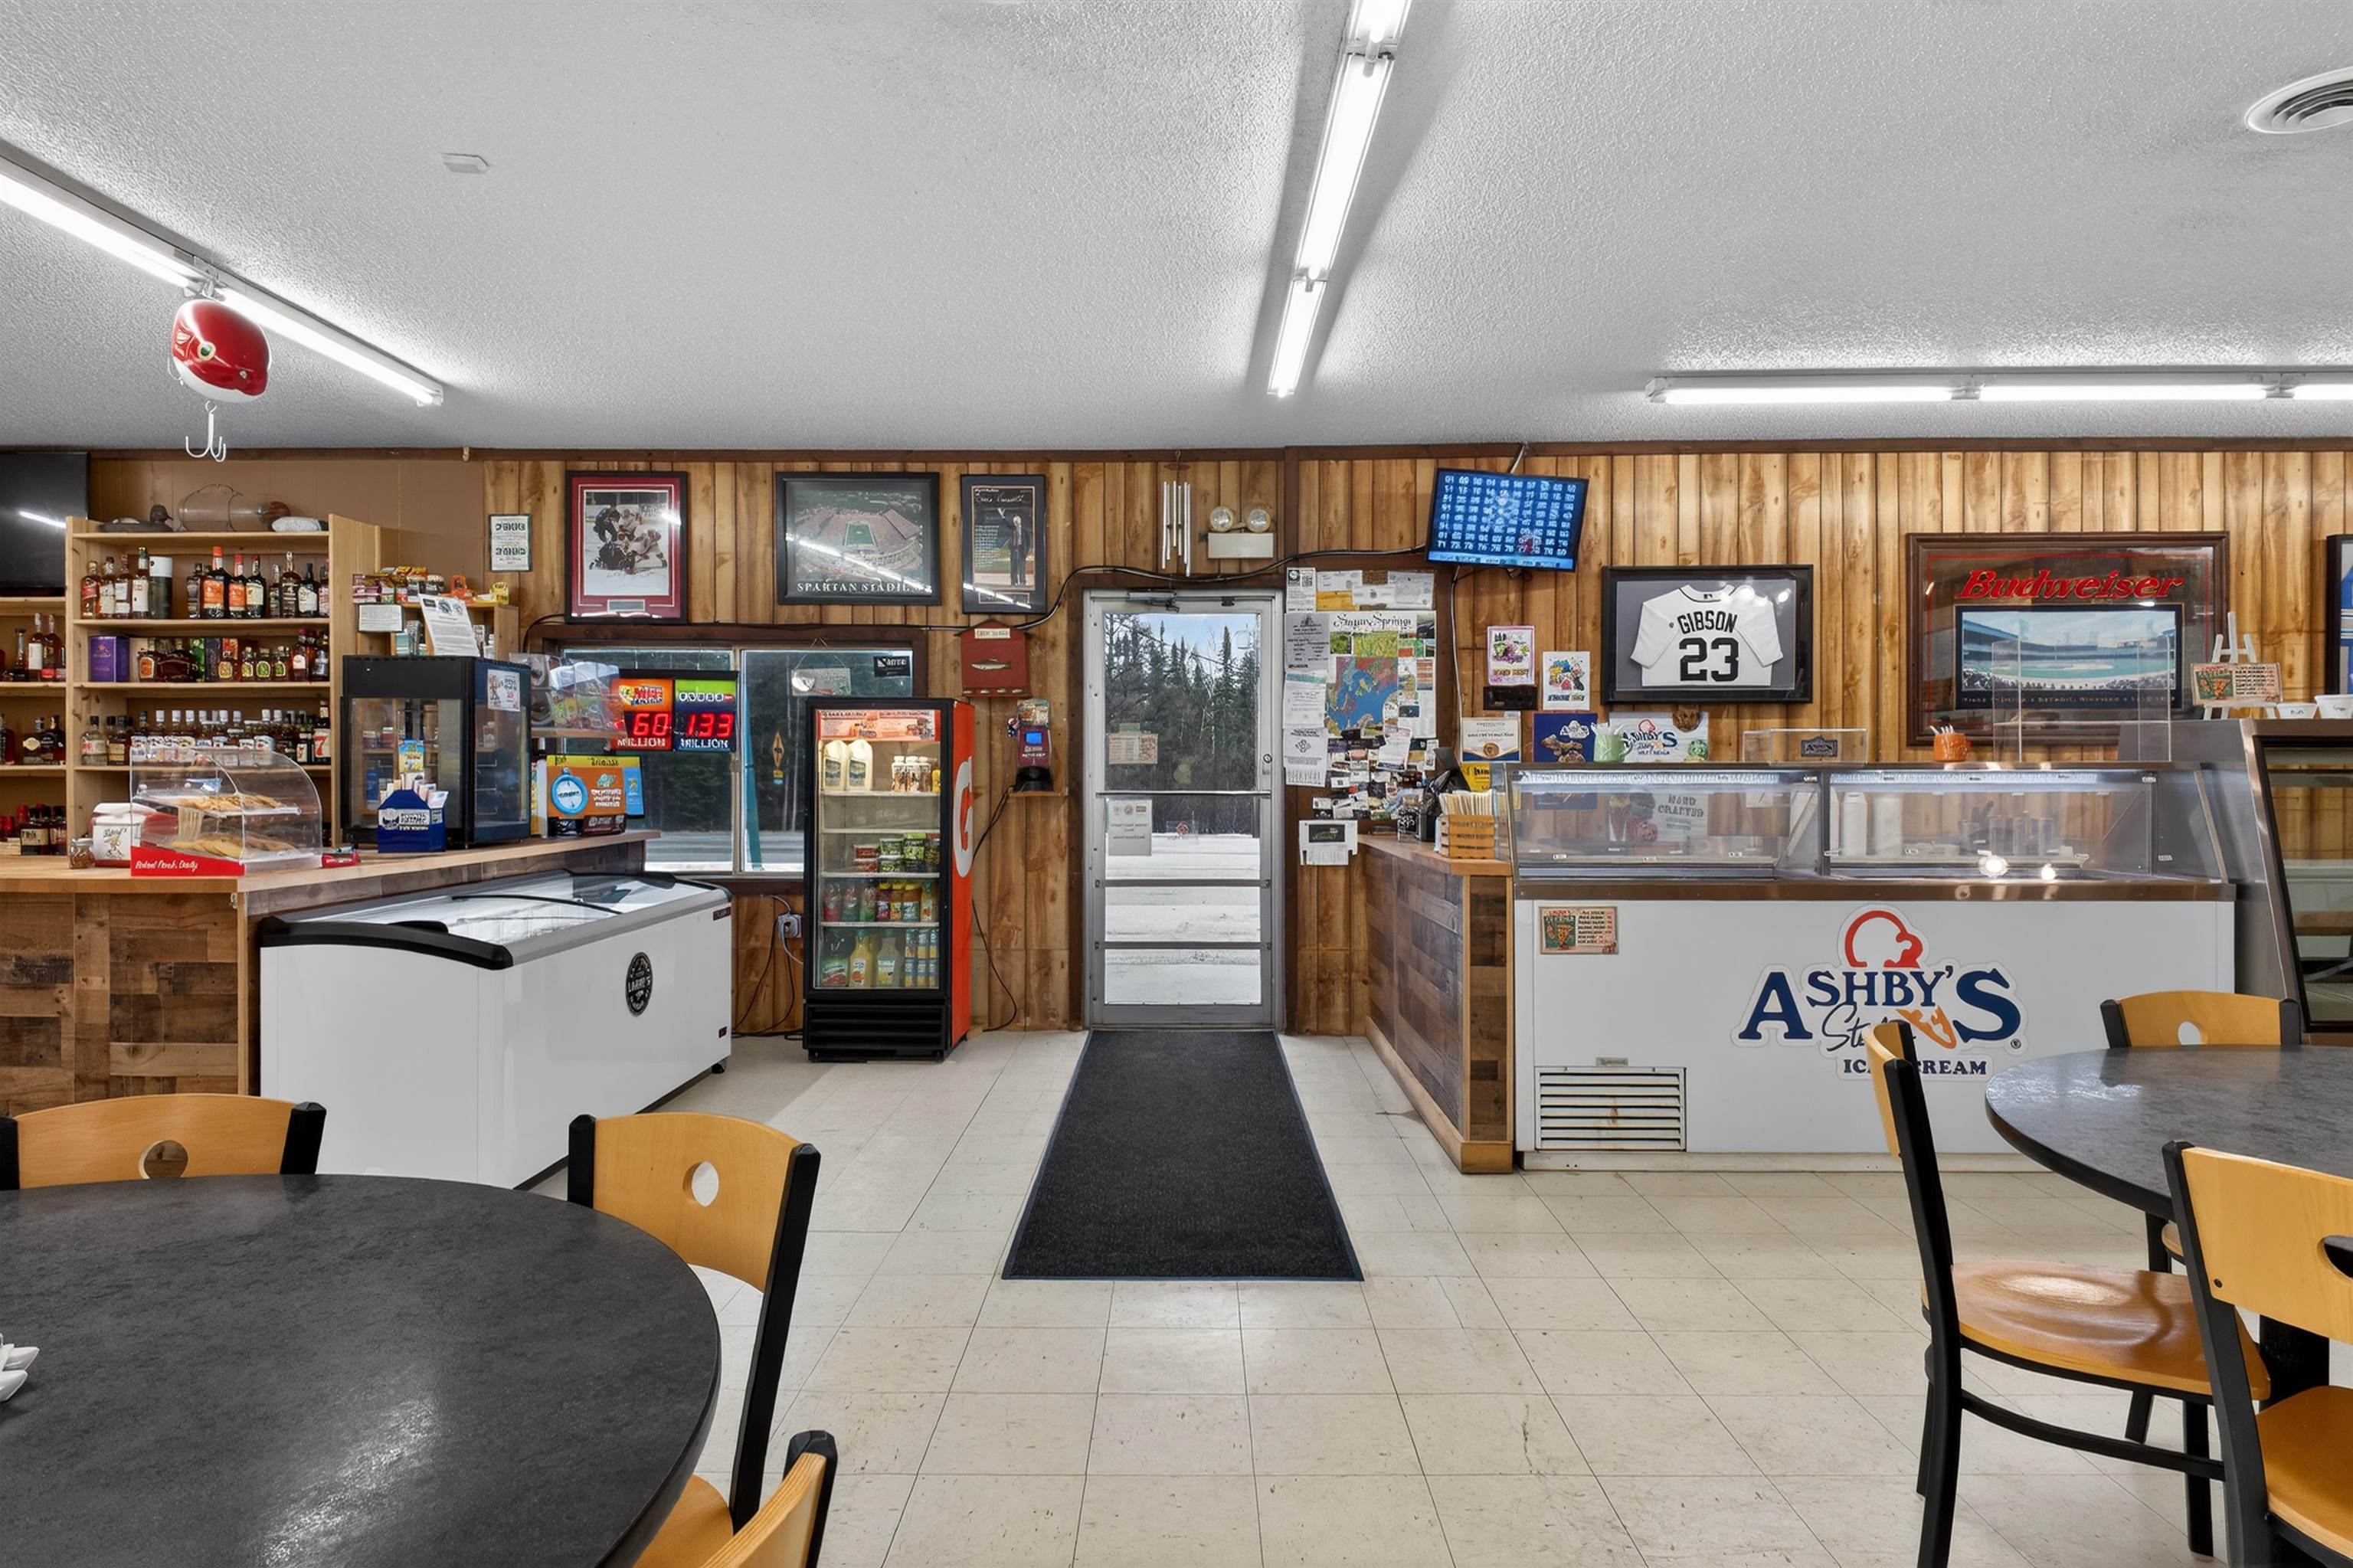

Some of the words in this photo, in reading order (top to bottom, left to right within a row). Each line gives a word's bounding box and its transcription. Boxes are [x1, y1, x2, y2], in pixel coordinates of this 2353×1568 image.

[797, 582, 858, 593] SPARTAN
[1954, 569, 2185, 599] Budweiser
[1677, 610, 1738, 634] GIBSON
[1679, 637, 1739, 682] 23
[633, 712, 669, 736] 60
[686, 712, 735, 738] 133
[617, 738, 666, 747] MILLION
[680, 738, 728, 748] MILLION
[1668, 794, 1697, 806] HAND
[1738, 965, 2022, 1043] ASHBY'S
[1843, 1059, 1871, 1074] IC
[1916, 1059, 1988, 1075] REAM
